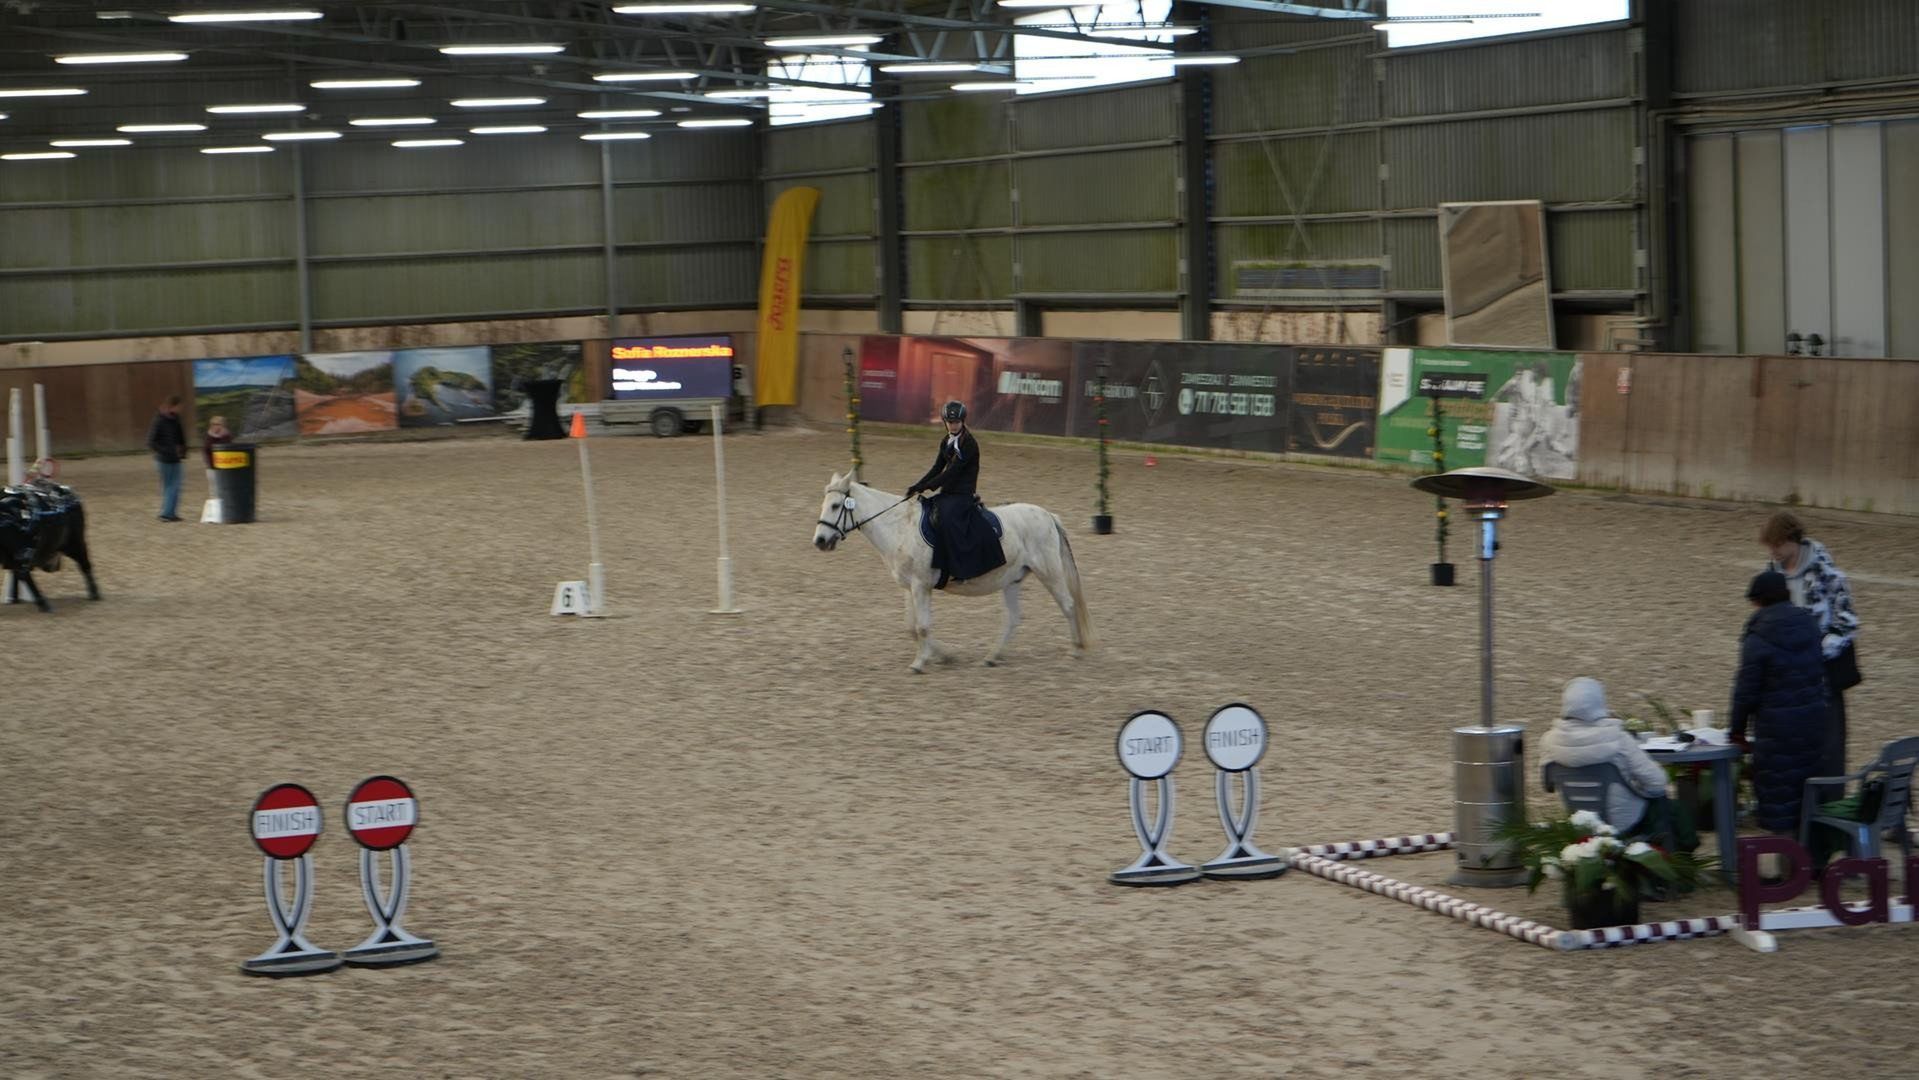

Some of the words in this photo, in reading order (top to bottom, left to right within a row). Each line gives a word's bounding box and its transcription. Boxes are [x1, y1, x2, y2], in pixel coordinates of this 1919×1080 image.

[1126, 735, 1175, 756] START
[1209, 728, 1260, 749] FINISH
[257, 811, 315, 834] FINISH
[354, 802, 407, 825] START
